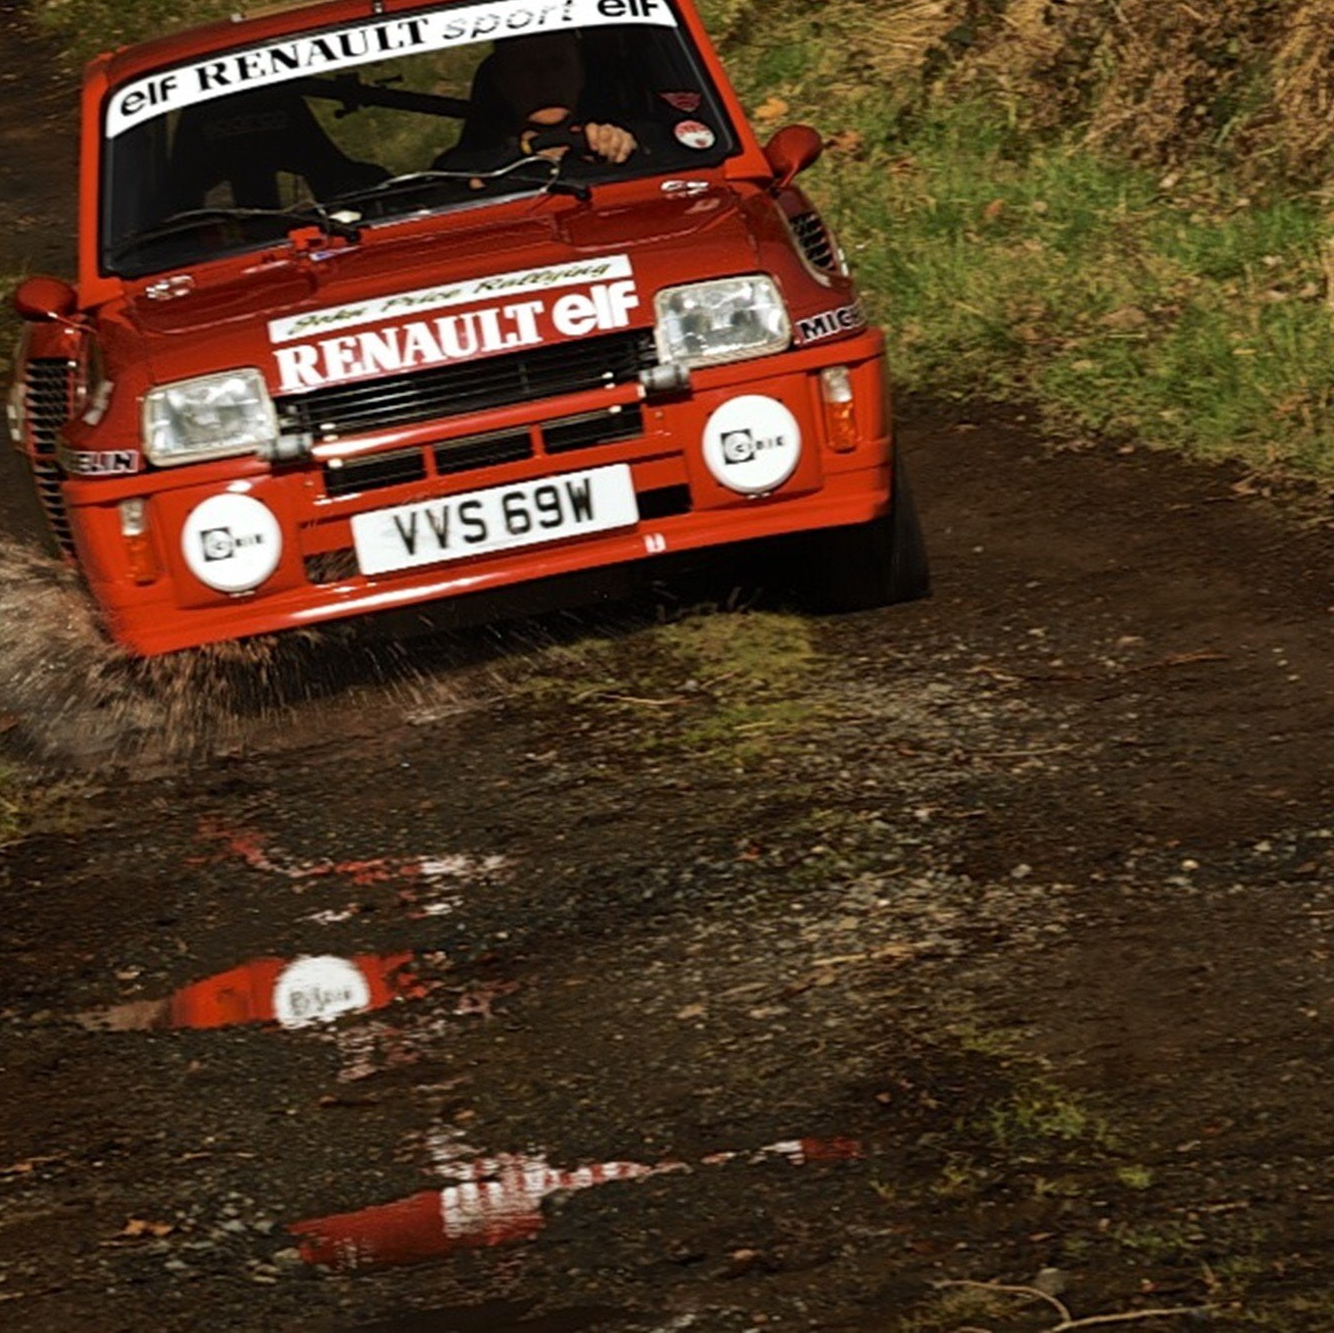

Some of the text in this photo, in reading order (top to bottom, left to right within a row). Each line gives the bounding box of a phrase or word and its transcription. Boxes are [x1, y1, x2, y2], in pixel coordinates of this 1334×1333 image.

[120, 75, 177, 117] elf
[194, 18, 429, 93] RENAULT
[442, 0, 574, 40] sport
[473, 263, 612, 294] Rallying
[272, 280, 640, 392] RENAULT elf
[394, 477, 594, 556] VVS 69W
